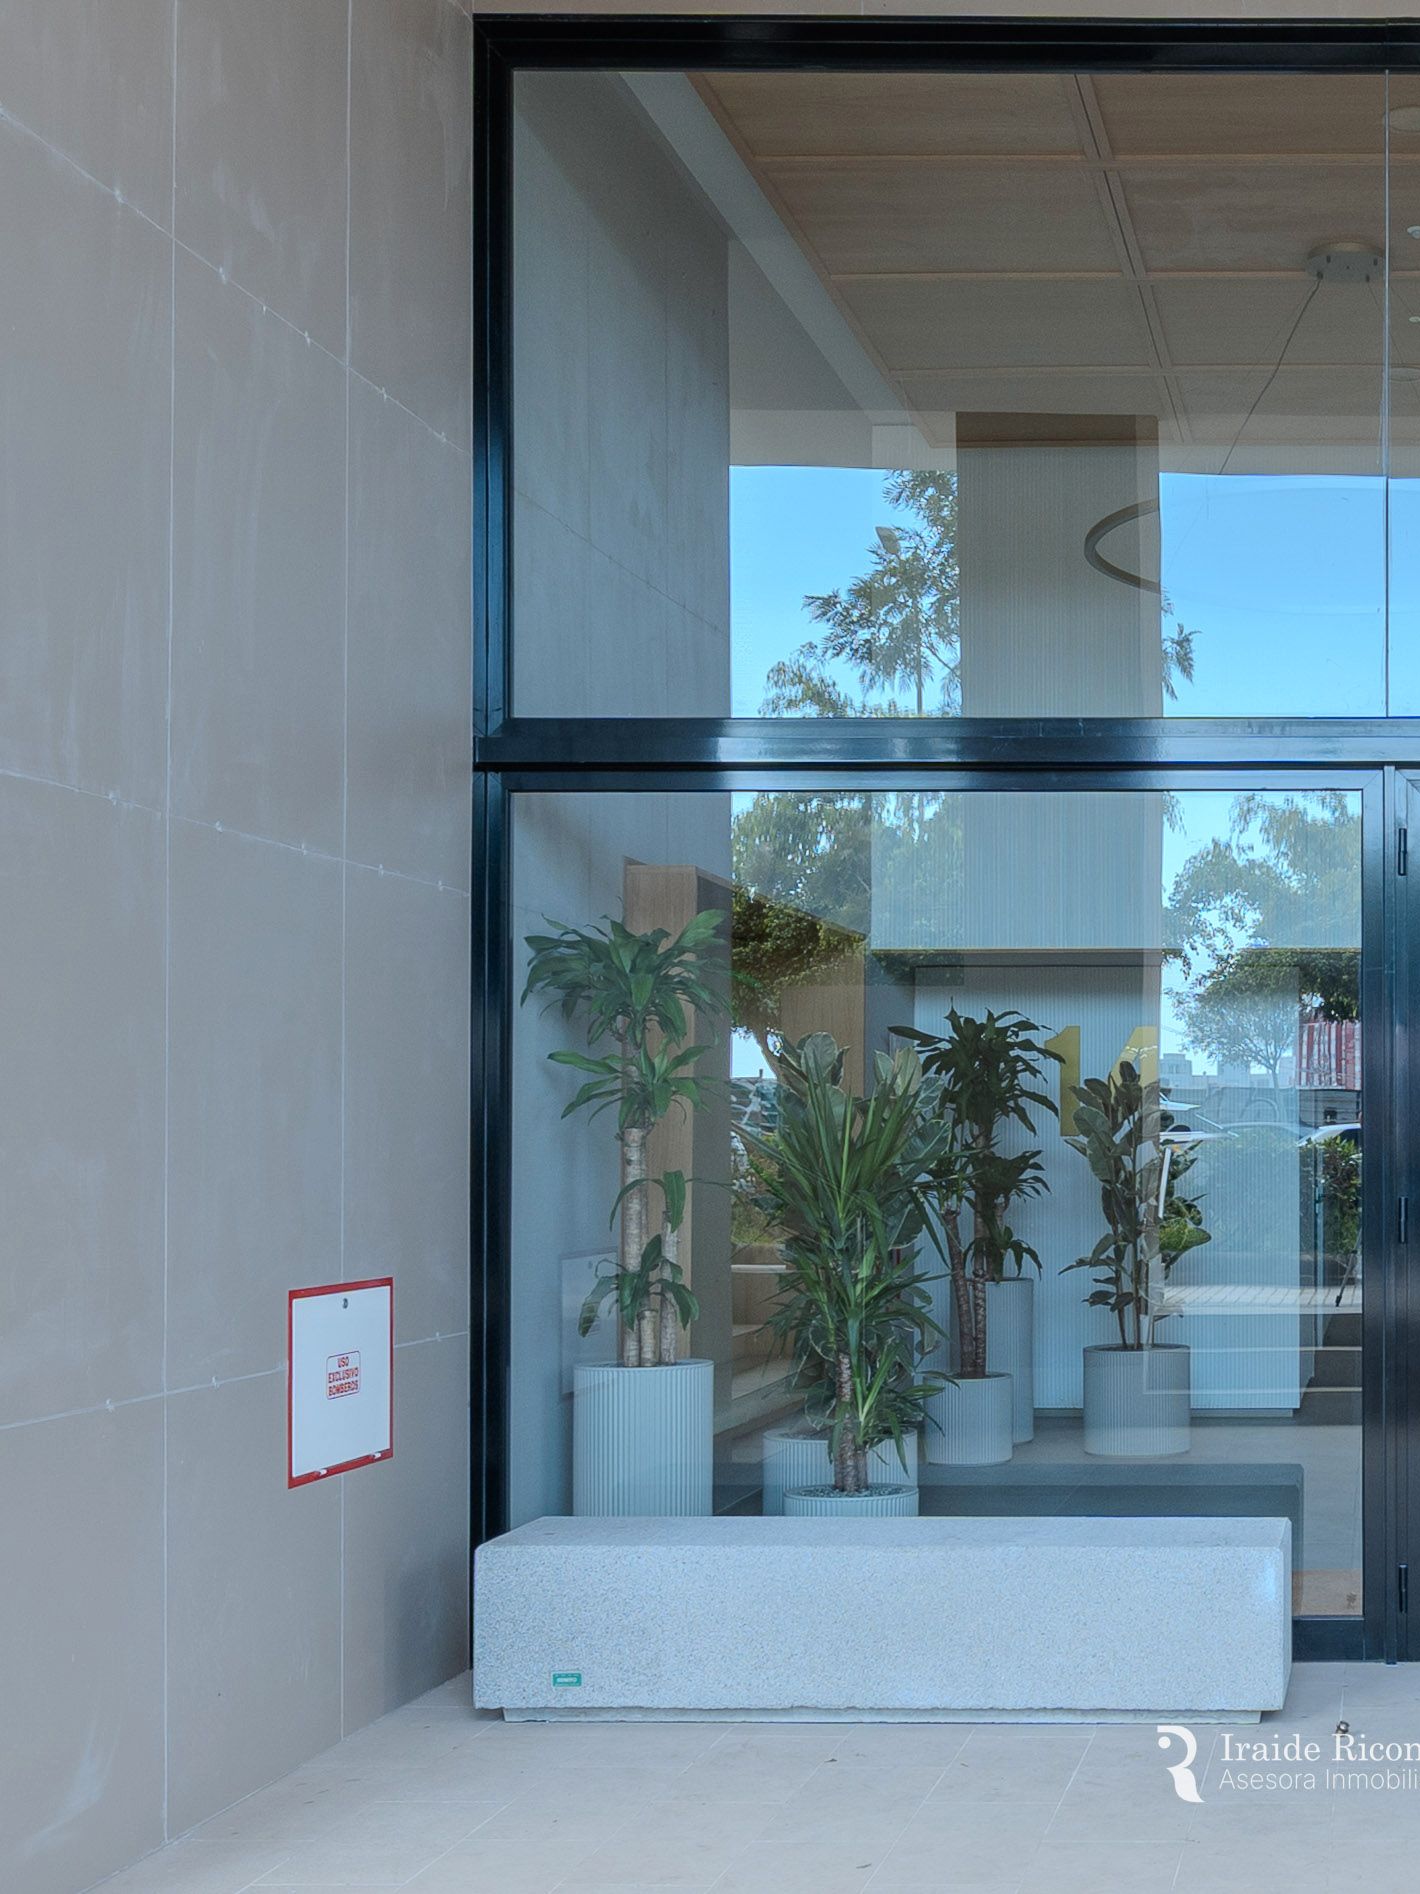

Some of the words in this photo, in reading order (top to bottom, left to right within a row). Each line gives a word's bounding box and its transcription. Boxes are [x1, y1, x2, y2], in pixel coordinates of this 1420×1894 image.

[337, 1356, 349, 1368] USO
[328, 1367, 358, 1383] EXCLUSIVO
[328, 1380, 358, 1396] BOMBEROS
